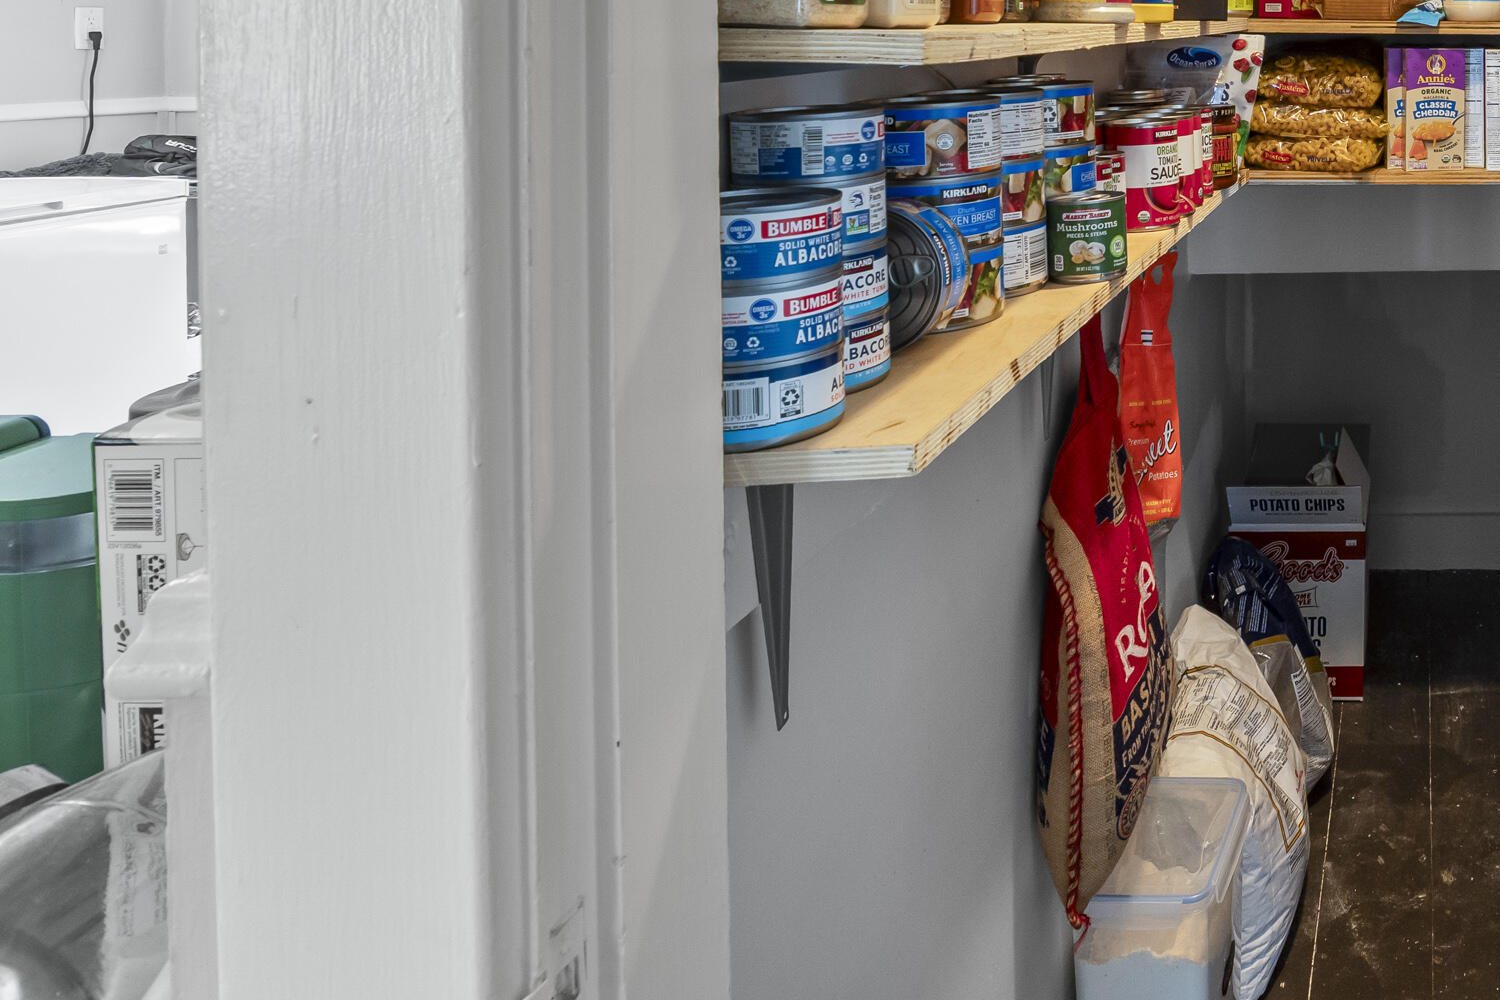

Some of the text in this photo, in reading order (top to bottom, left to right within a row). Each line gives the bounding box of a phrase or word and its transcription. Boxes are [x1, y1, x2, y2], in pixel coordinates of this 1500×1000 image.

[1170, 53, 1218, 69] Ocean Spray
[1416, 75, 1455, 84] Annie's
[1421, 88, 1452, 96] ORGANIC
[1151, 164, 1182, 180] SAUCE
[943, 185, 988, 198] KIRKLAND
[971, 210, 996, 223] BREAST
[768, 216, 826, 237] BUMBLE
[1056, 220, 1118, 232] Mushrooms
[778, 236, 830, 250] SOLID WHITE
[934, 234, 950, 286] KIRKLAND
[752, 305, 774, 313] OMEGA
[789, 290, 838, 315] BUMBLE
[800, 317, 822, 328] SOLID
[851, 323, 884, 339] KIRKLAND
[1148, 470, 1178, 482] Potatoes
[1250, 498, 1345, 512] POTATO CHIPS
